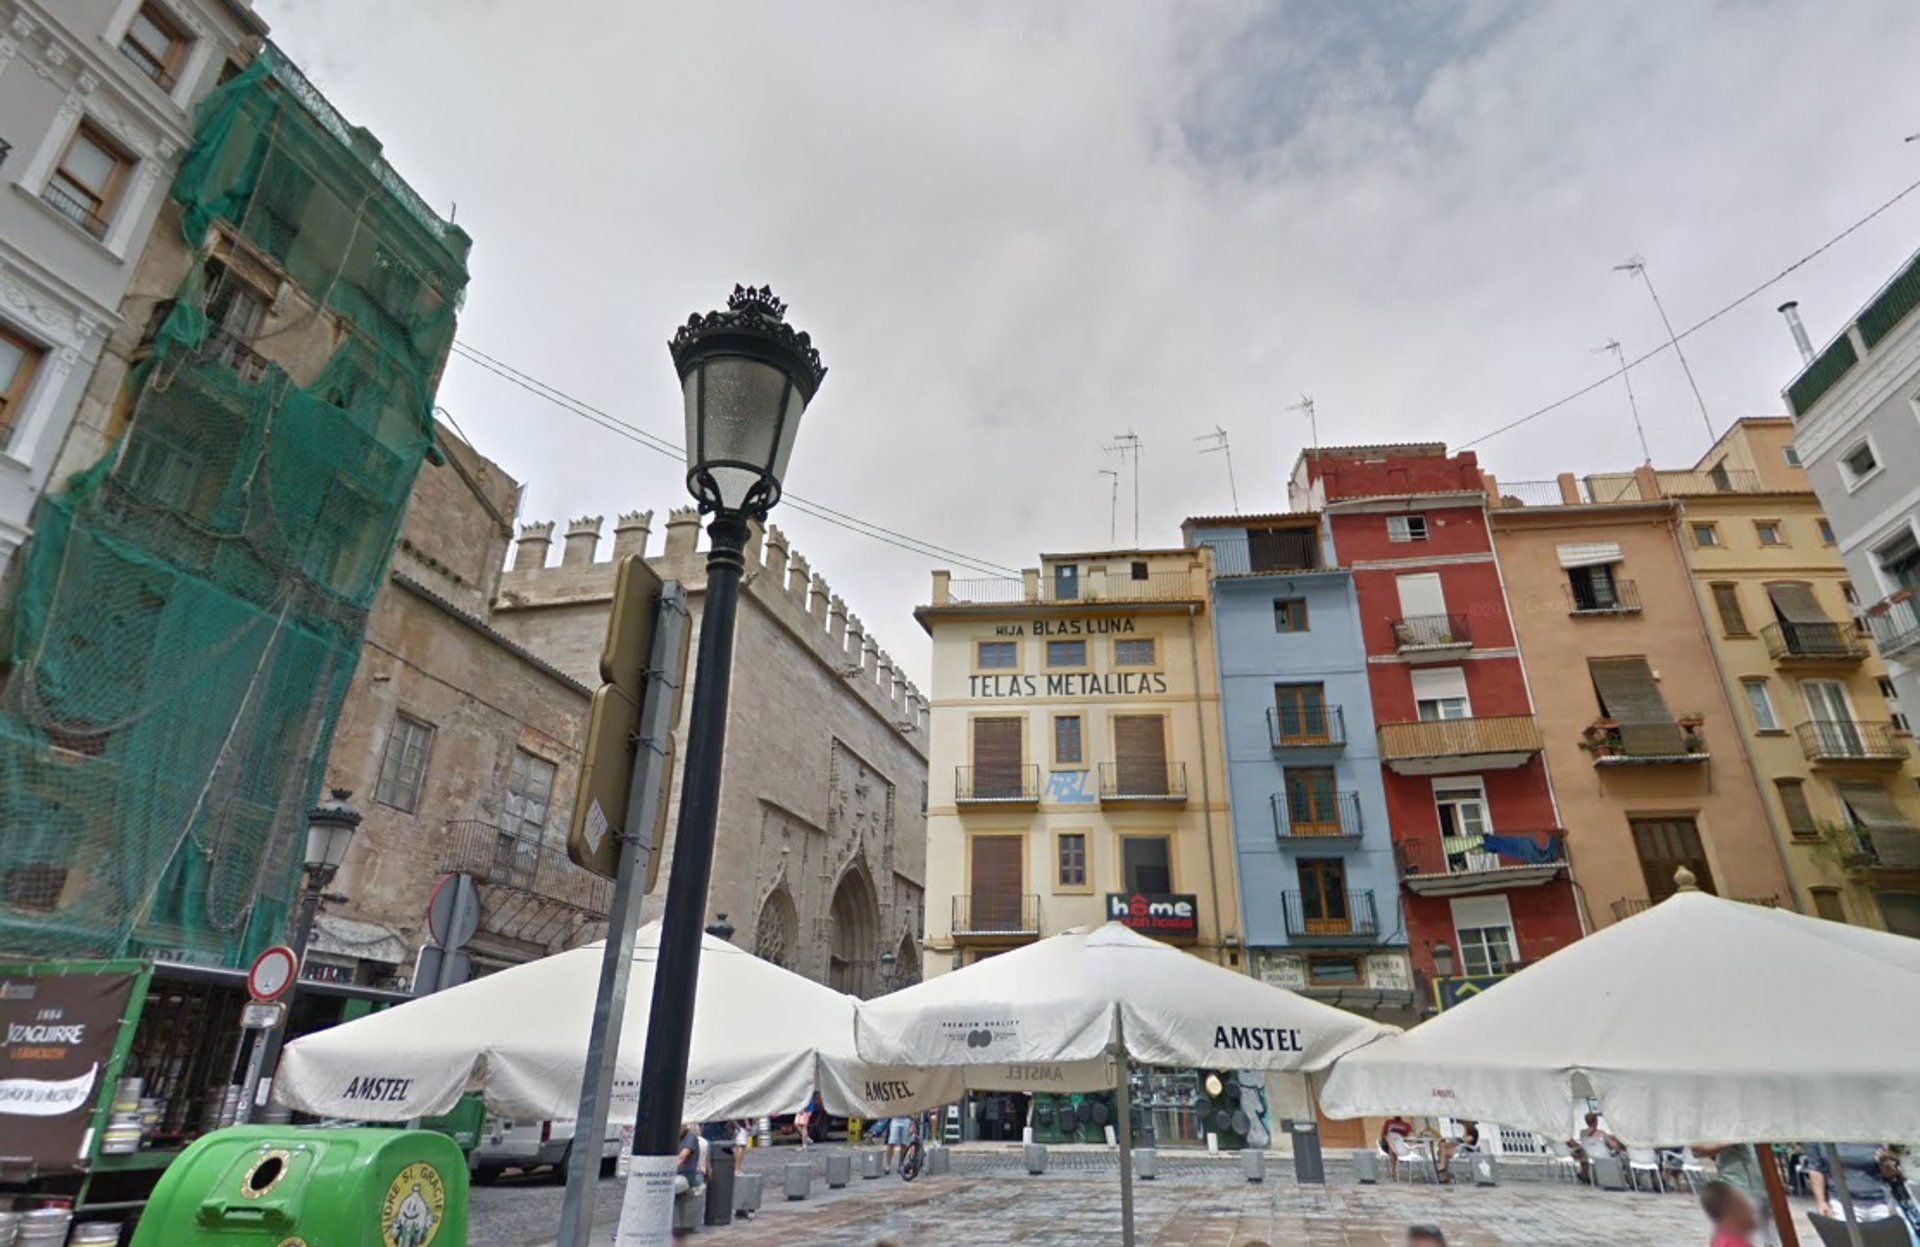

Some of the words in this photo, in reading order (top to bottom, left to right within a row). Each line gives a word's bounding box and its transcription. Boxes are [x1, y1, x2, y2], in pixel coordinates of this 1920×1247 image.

[997, 625, 1024, 637] HIJA
[1033, 619, 1081, 635] BLAS
[1086, 617, 1135, 634] LUNA
[969, 675, 1036, 697] TELAS
[1047, 673, 1167, 695] METALICAS
[1112, 893, 1192, 917] home
[1214, 1025, 1303, 1051] AMSTEL
[342, 1076, 408, 1101] AMSTEL
[865, 1081, 914, 1101] AMSTEL
